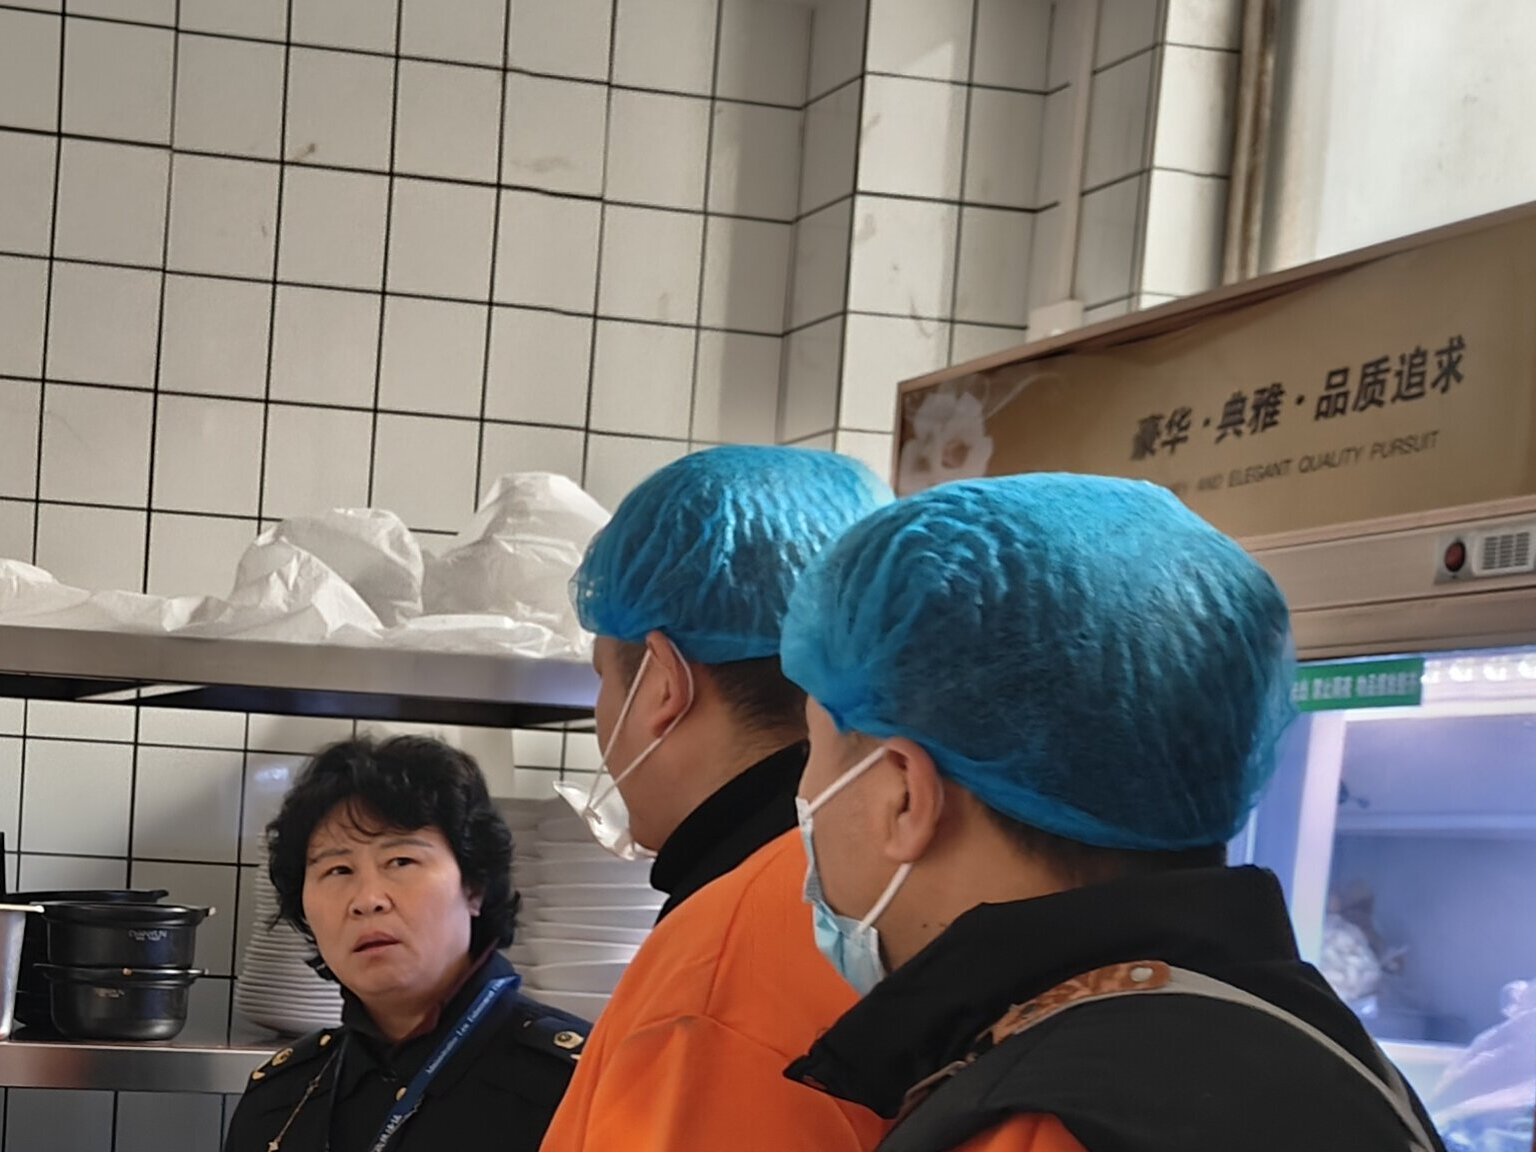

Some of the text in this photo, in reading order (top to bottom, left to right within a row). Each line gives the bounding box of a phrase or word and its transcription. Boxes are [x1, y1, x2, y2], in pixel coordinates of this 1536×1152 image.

[1227, 458, 1292, 488] ELEGANT
[1298, 447, 1362, 474] QUALITY
[1369, 430, 1440, 460] PURSUIT
